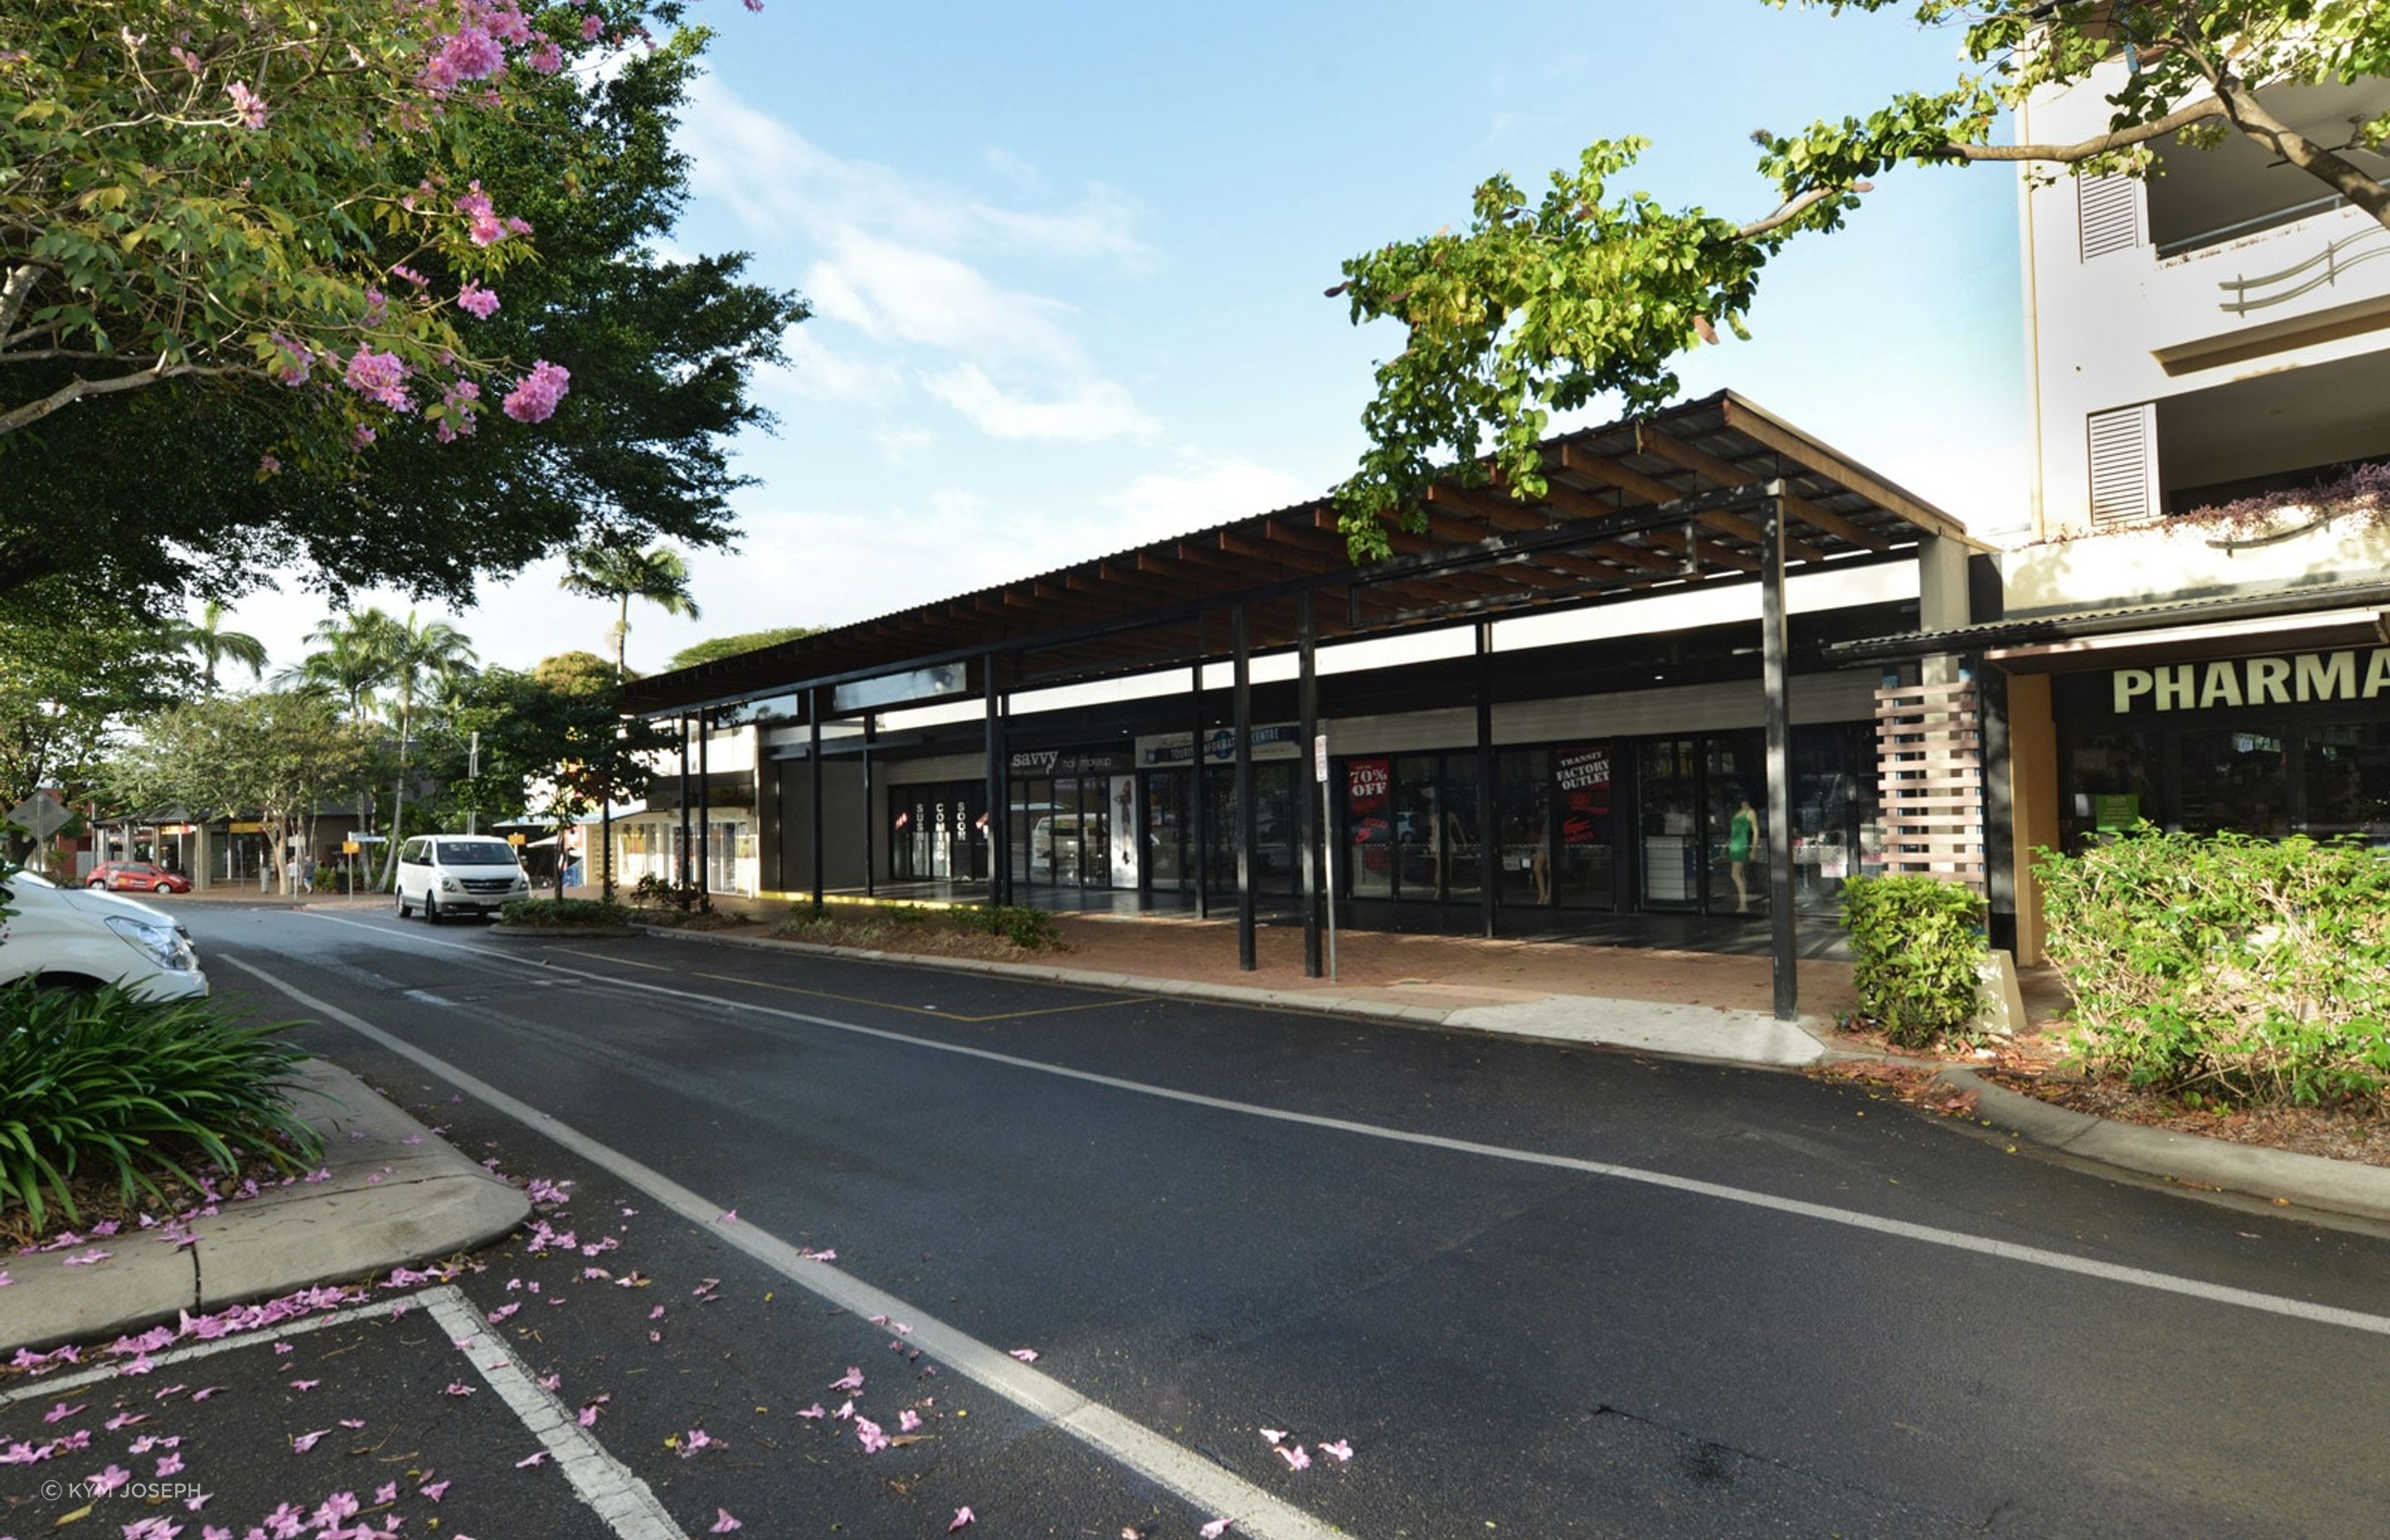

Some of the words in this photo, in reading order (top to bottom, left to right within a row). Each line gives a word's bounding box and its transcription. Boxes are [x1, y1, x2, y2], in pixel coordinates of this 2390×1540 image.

[2114, 648, 2390, 714] PHARMA
[1251, 727, 1280, 744] CENTRE
[1012, 750, 1059, 775] savvy
[1556, 758, 1610, 781] FACTORY
[1561, 751, 1602, 767] TRANSIT
[1350, 769, 1388, 784] 70%
[1562, 770, 1610, 790] OUTLET
[1352, 782, 1386, 797] OFF
[935, 803, 945, 860] COMING
[957, 802, 966, 841] SOON
